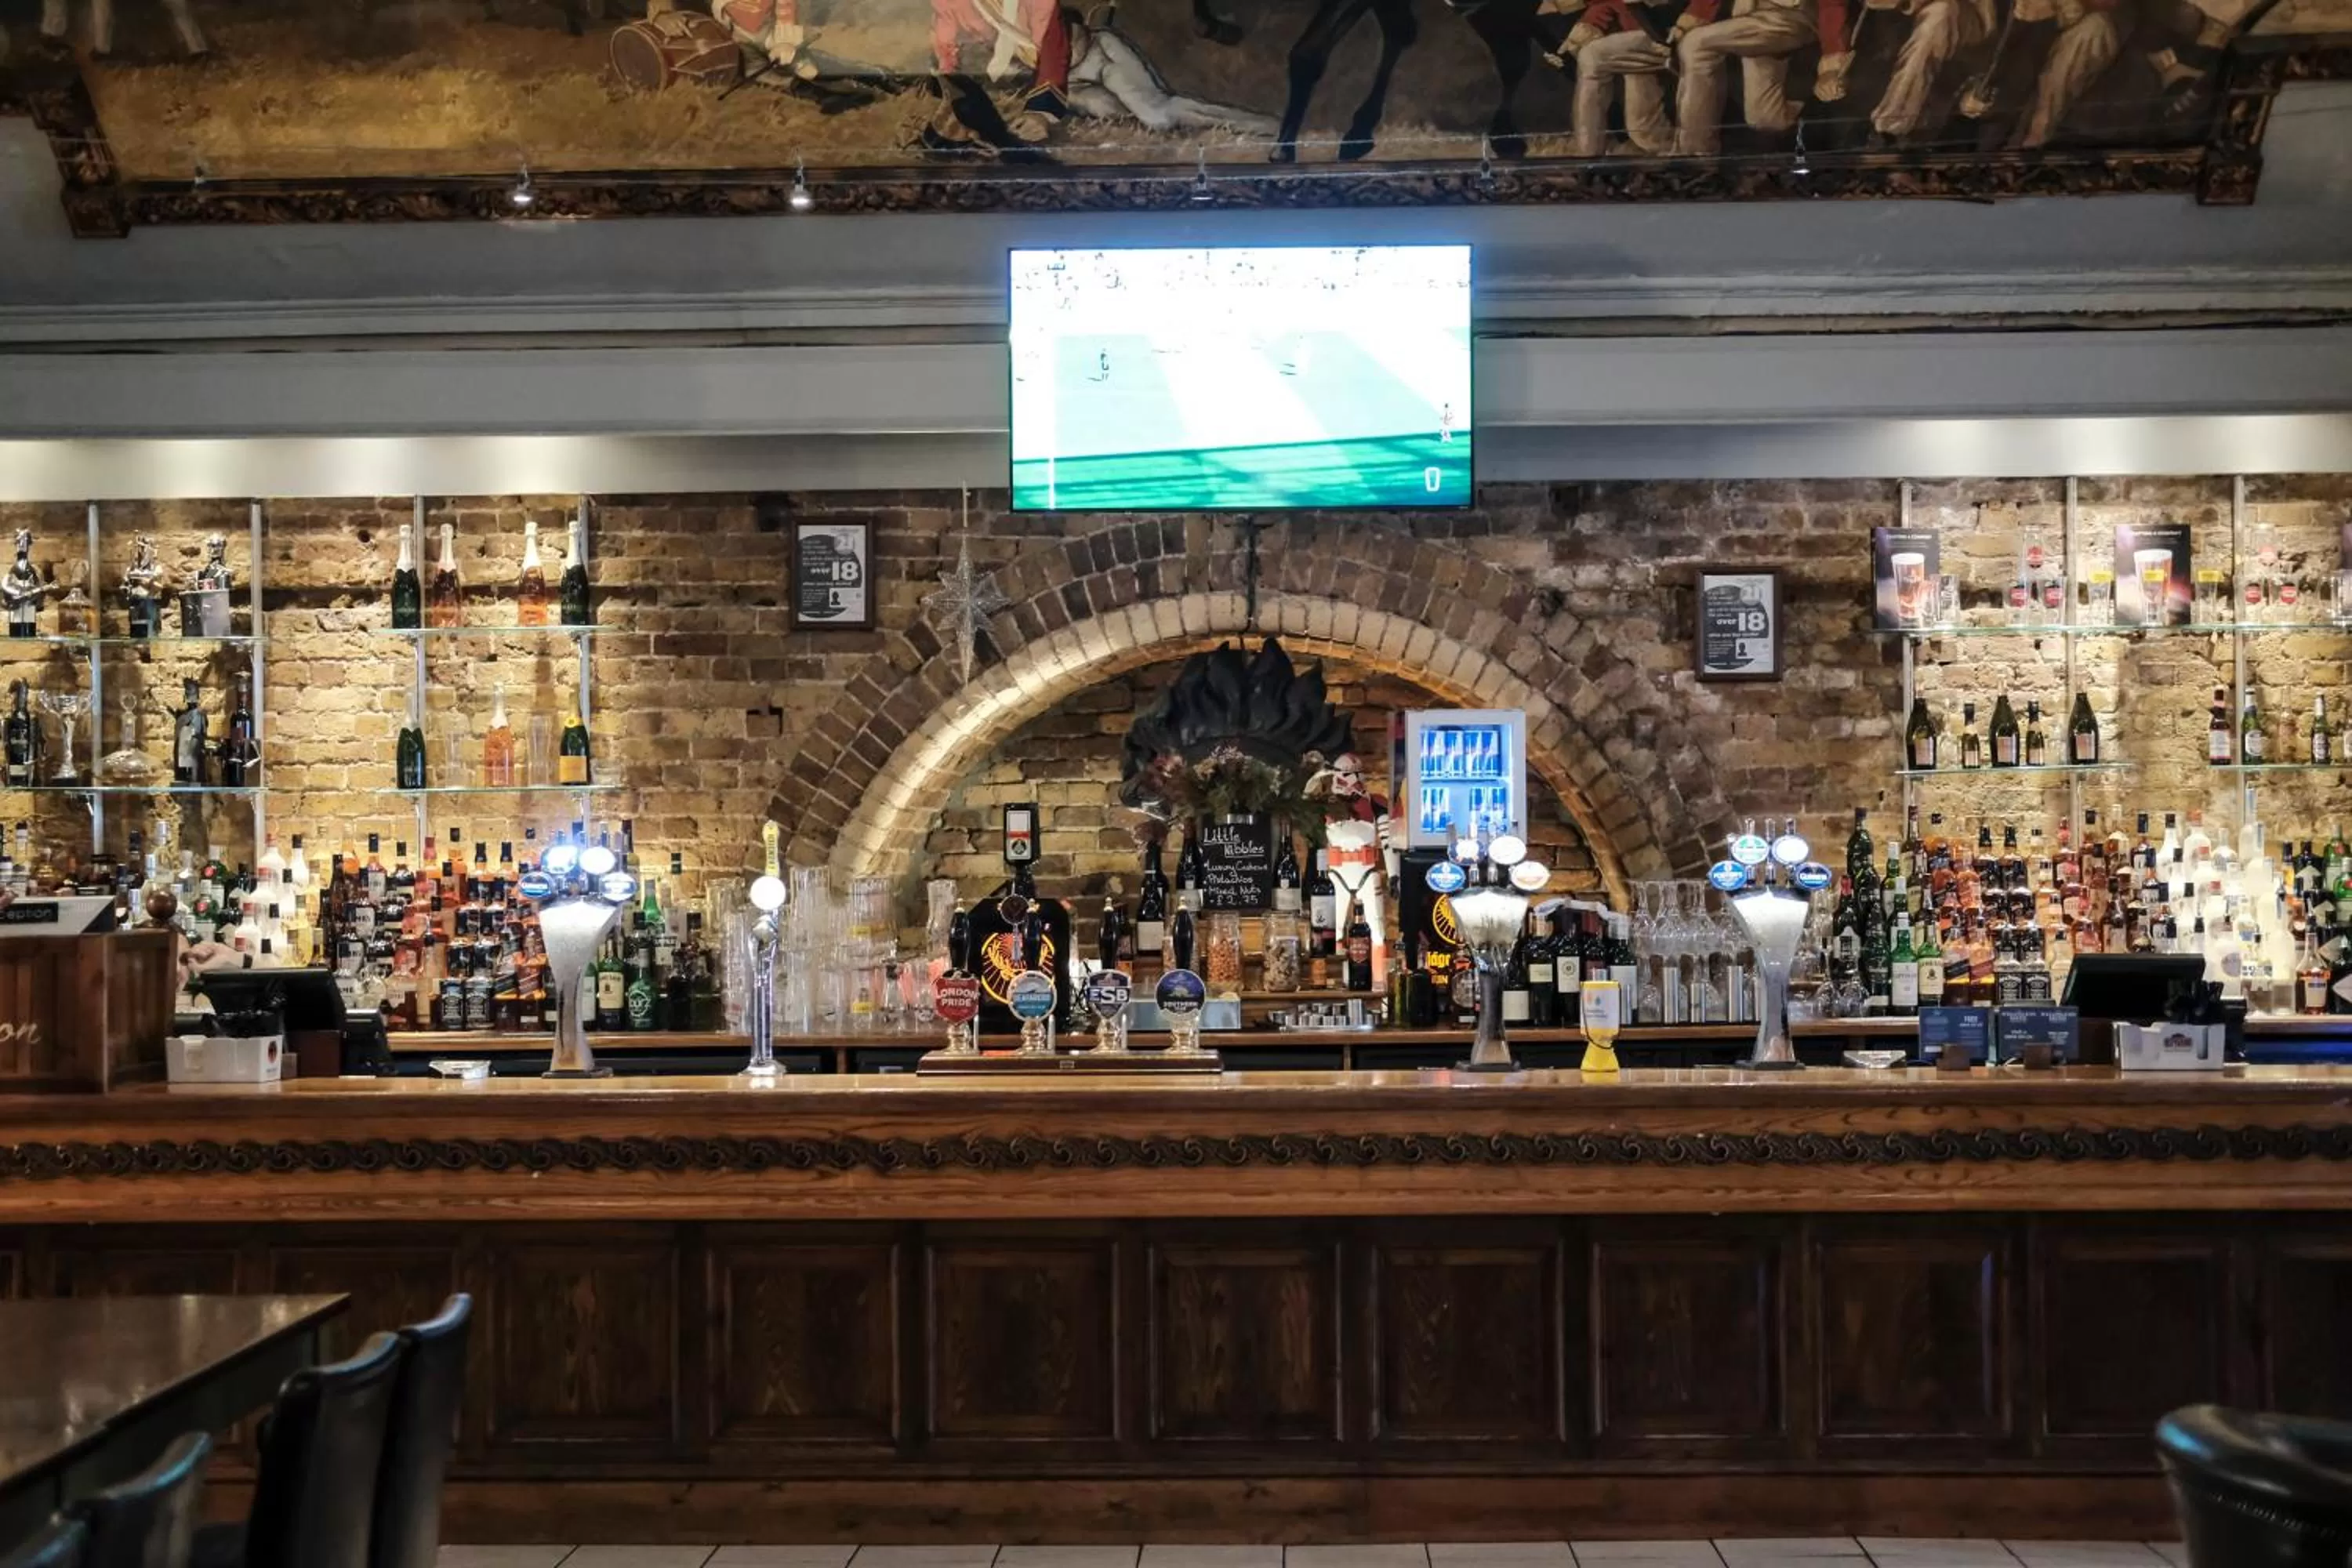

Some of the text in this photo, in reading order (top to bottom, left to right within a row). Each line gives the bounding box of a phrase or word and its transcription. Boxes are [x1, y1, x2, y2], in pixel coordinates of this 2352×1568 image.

[833, 561, 858, 581] 18
[1738, 612, 1766, 631] 18
[1203, 826, 1240, 842] Little
[1224, 840, 1265, 855] Nibbles
[935, 987, 980, 1000] LONDON
[1089, 987, 1127, 1004] ESB
[942, 999, 972, 1007] PRIDE
